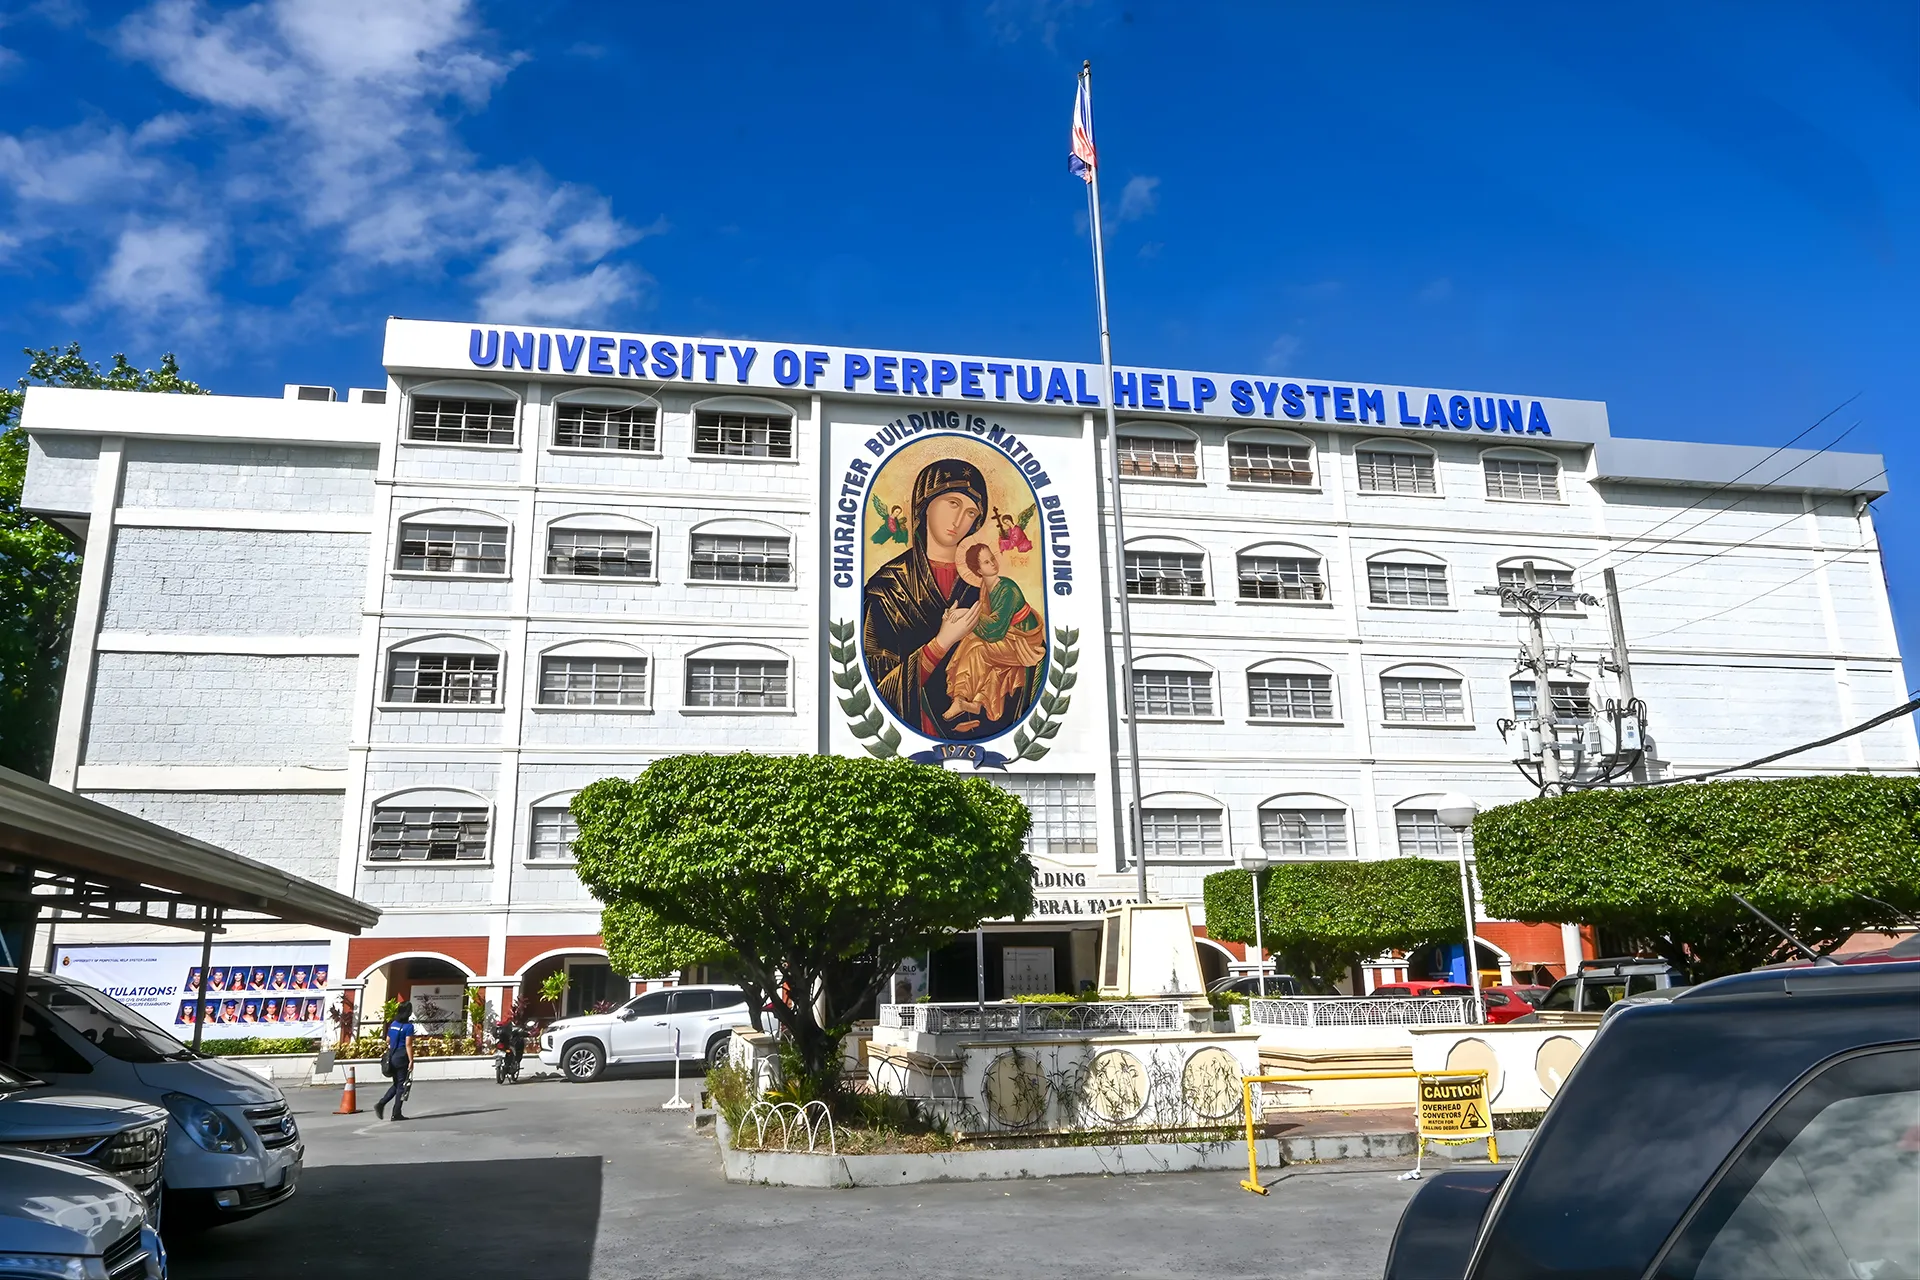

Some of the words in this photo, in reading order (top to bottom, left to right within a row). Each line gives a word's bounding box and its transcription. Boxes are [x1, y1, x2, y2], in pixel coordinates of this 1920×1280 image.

[469, 328, 757, 383] UNIVERSITY
[773, 349, 830, 387] OF
[843, 353, 1099, 406] PERPETUAL
[1113, 371, 1217, 411] HELP
[1230, 380, 1385, 423] SYSTEM
[1399, 391, 1551, 435] LAGUNA
[833, 458, 872, 588] CHARACTER
[864, 410, 960, 457] BUILDING
[965, 414, 986, 434] IS
[989, 423, 1052, 490] NATION
[1042, 495, 1073, 596] BUILDING
[941, 745, 976, 759] 1976
[1034, 873, 1086, 888] LDING
[1032, 899, 1083, 915] PERAL
[102, 986, 178, 997] ATULATIONS!
[1424, 1084, 1480, 1099] CAUTION
[1422, 1103, 1462, 1111] OVERHEAD
